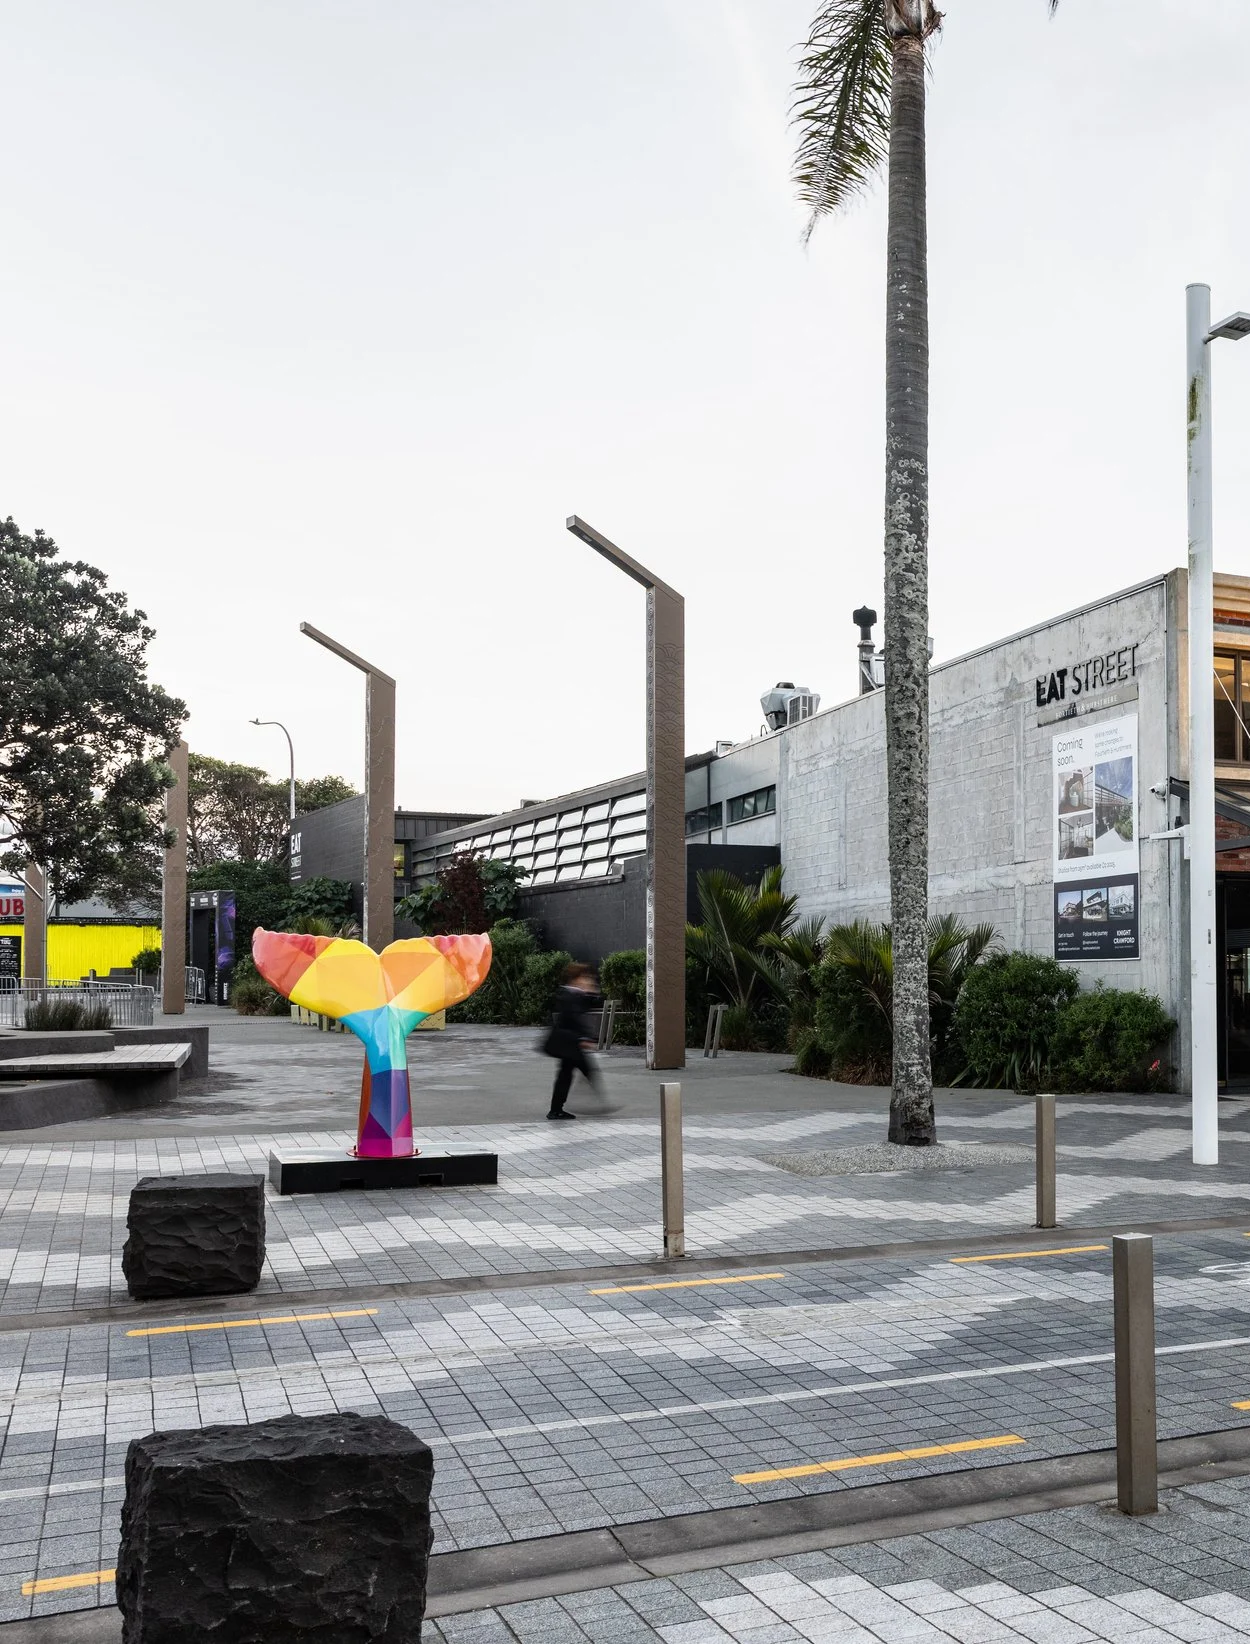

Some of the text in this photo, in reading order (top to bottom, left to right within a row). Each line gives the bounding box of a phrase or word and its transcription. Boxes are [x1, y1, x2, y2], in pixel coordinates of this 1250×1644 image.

[1036, 643, 1138, 707] EAT STREET
[1057, 738, 1083, 752] Coming
[1057, 754, 1075, 766] soon.
[291, 832, 302, 854] EAT
